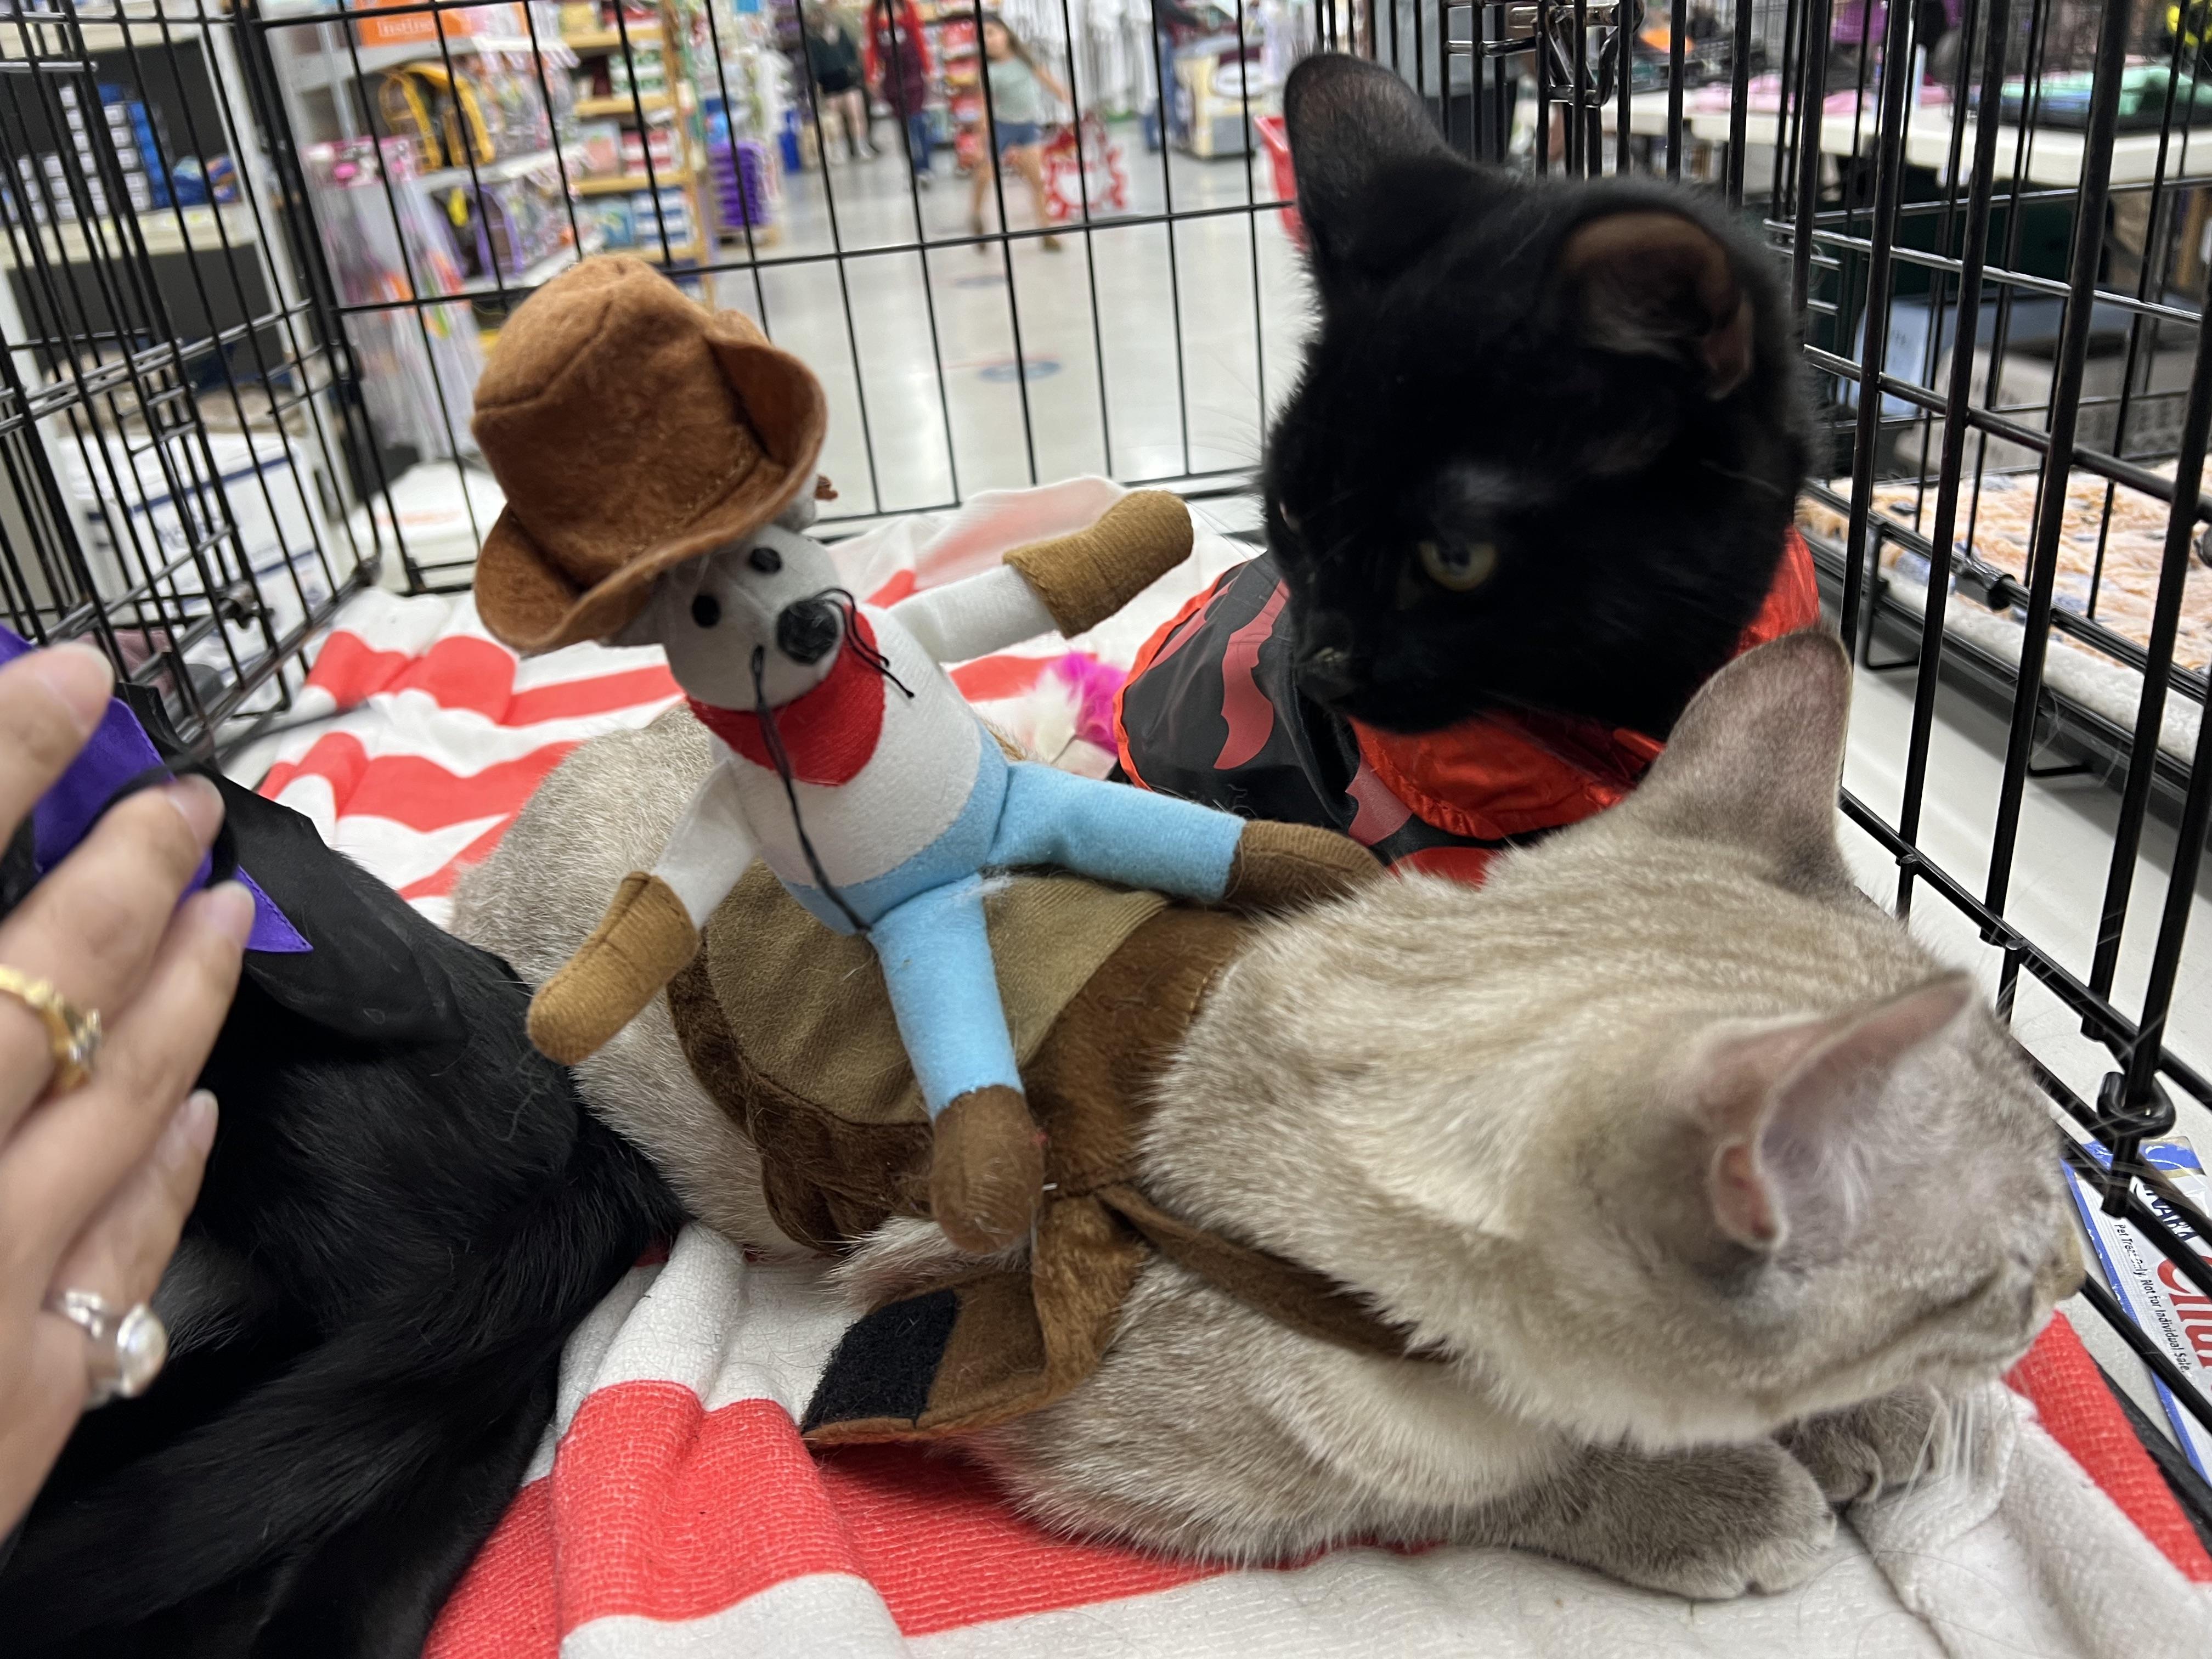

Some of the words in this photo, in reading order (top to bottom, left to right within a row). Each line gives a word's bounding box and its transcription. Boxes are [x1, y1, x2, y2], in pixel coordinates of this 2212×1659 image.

[2114, 1224, 2129, 1236] Pet
[2141, 1280, 2156, 1294] Not
[2148, 1295, 2162, 1307] for
[2155, 1310, 2185, 1350] Individual
[2174, 1352, 2192, 1373] Sale.
